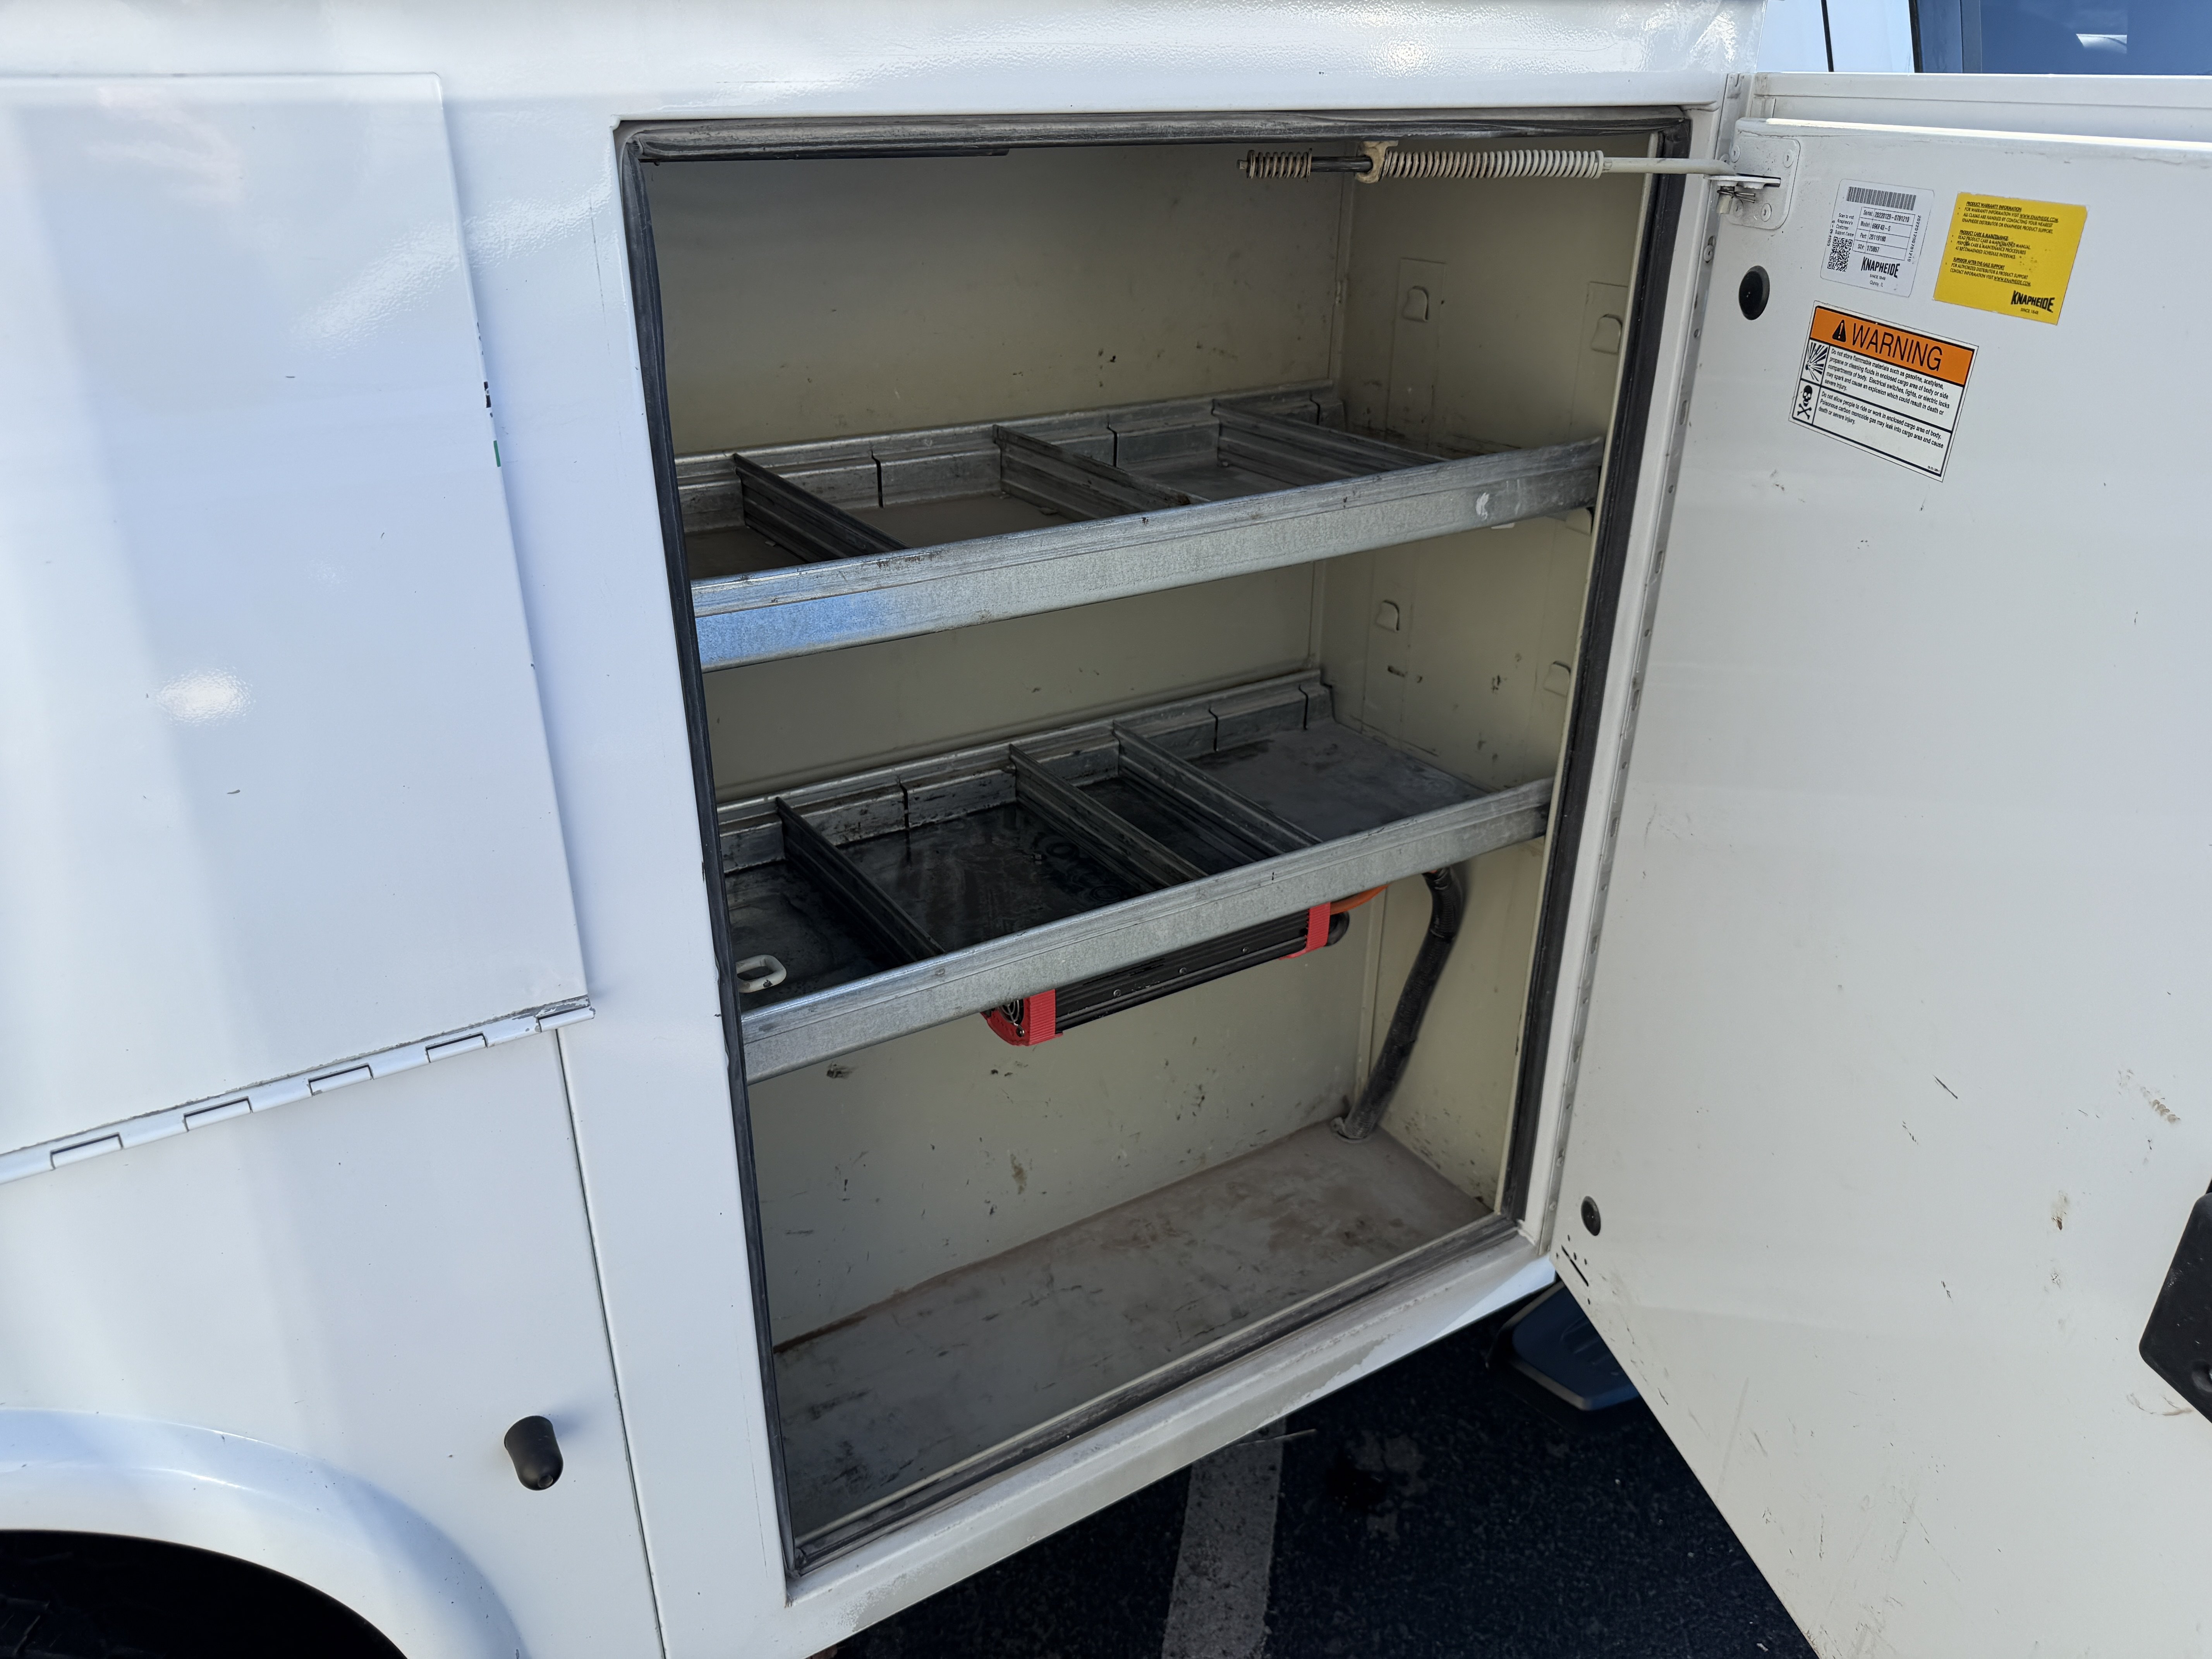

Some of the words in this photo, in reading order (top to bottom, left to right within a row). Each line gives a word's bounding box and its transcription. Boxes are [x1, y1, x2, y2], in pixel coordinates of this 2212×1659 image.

[1861, 256, 1900, 278] KNAPHEIDE
[2011, 290, 2055, 313] KNAPHEIDE
[1852, 323, 1943, 372] WARNING
[1872, 363, 1889, 371] materials
[1849, 363, 1864, 373] cleaning
[1880, 373, 1897, 383] enclosed
[1923, 386, 1934, 395] body
[1868, 386, 1886, 395] explosion
[1869, 377, 1886, 387] Electrical
[1923, 395, 1938, 405] electric
[1939, 400, 1949, 409] locks
[1886, 416, 1904, 425] enclosed
[1902, 429, 1913, 438] cargo
[1931, 440, 1943, 448] cause
